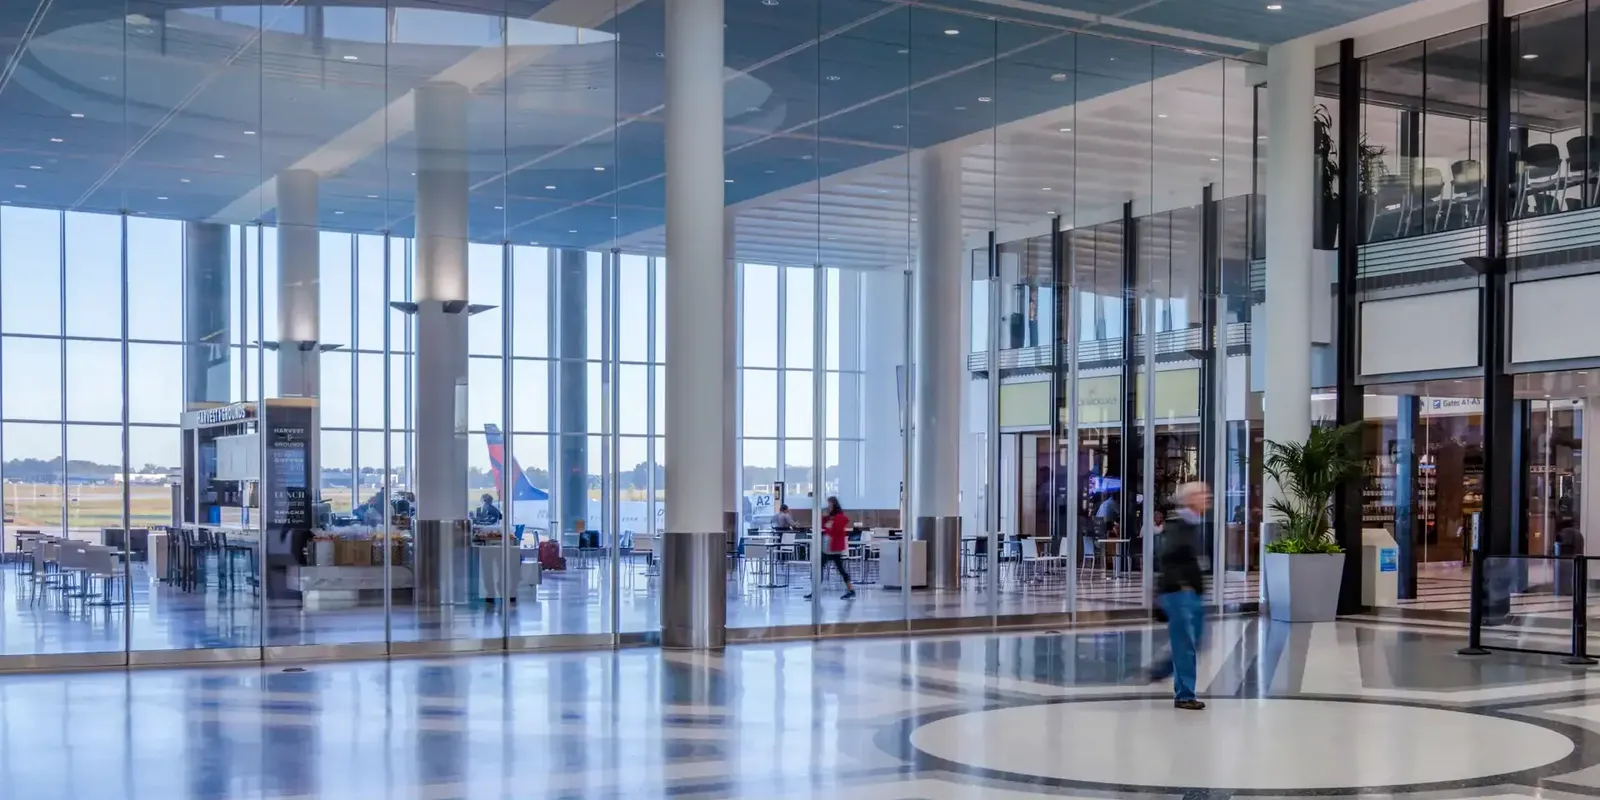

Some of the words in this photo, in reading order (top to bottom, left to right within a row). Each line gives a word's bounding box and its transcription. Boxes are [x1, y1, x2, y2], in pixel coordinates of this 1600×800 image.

[198, 408, 219, 423] HARVEST
[223, 404, 246, 421] GROUNDS
[756, 495, 771, 506] A2
